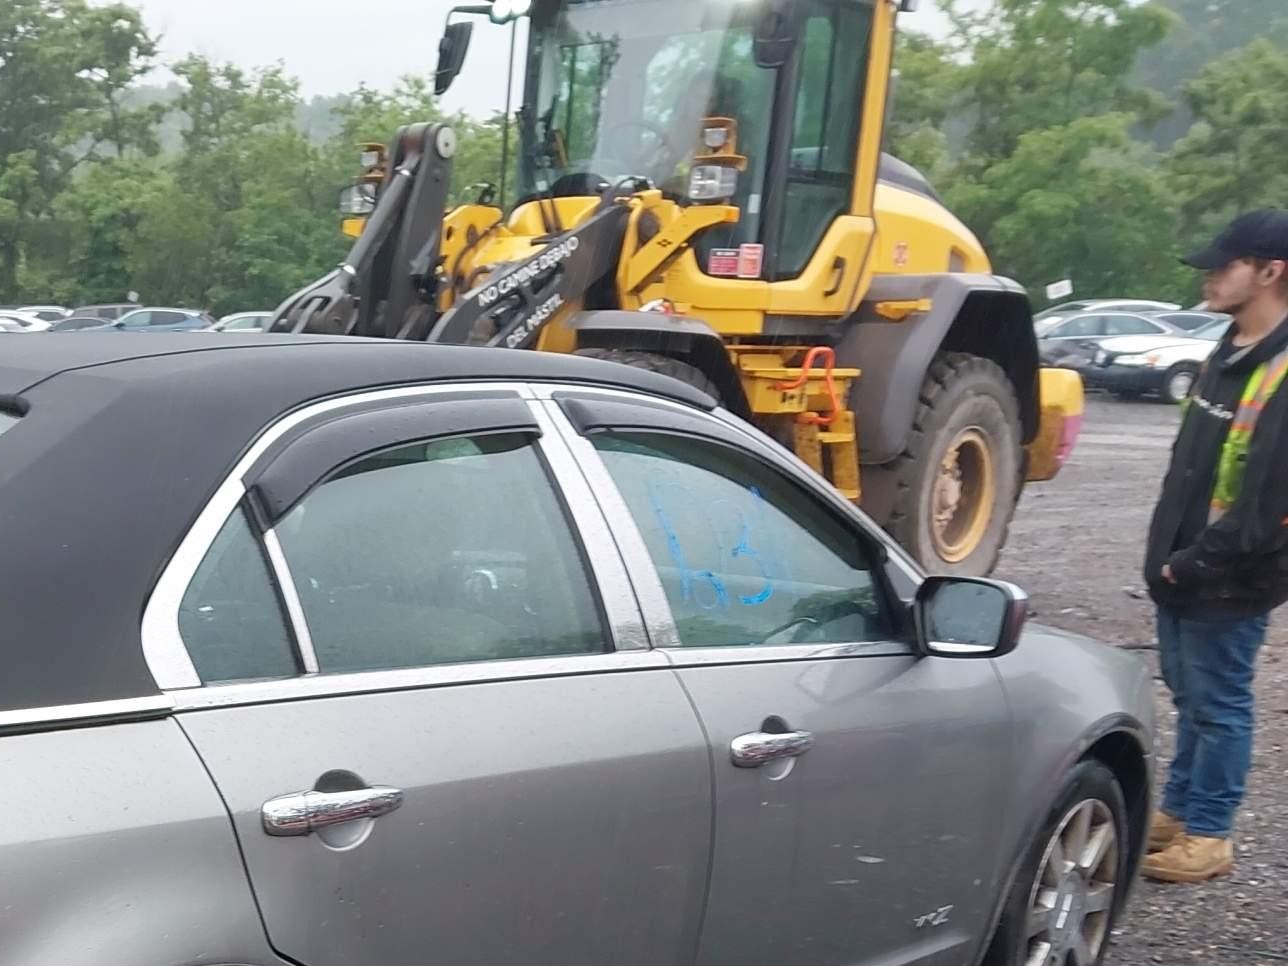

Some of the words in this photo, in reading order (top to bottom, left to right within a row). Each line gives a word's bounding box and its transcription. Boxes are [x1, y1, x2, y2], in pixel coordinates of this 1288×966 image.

[478, 286, 499, 307] NO
[498, 259, 540, 294] CAMINE
[506, 326, 528, 349] DEL
